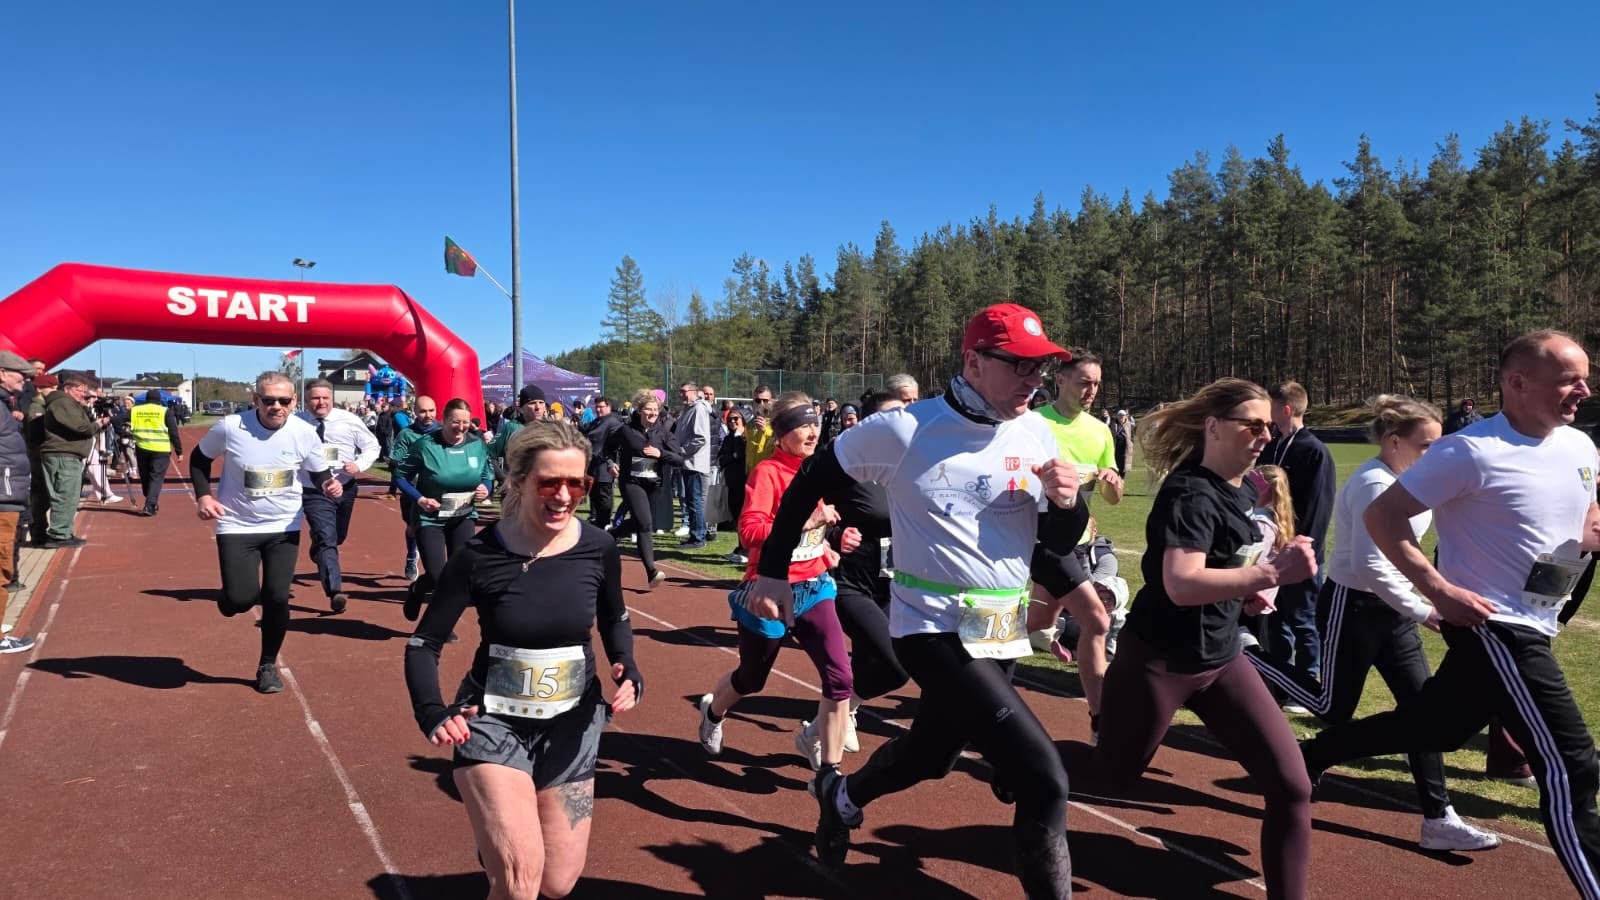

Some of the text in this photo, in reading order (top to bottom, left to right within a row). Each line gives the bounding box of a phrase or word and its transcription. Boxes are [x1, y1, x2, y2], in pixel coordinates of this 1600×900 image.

[166, 286, 316, 323] START
[980, 612, 1012, 641] 18
[516, 666, 561, 698] 15
